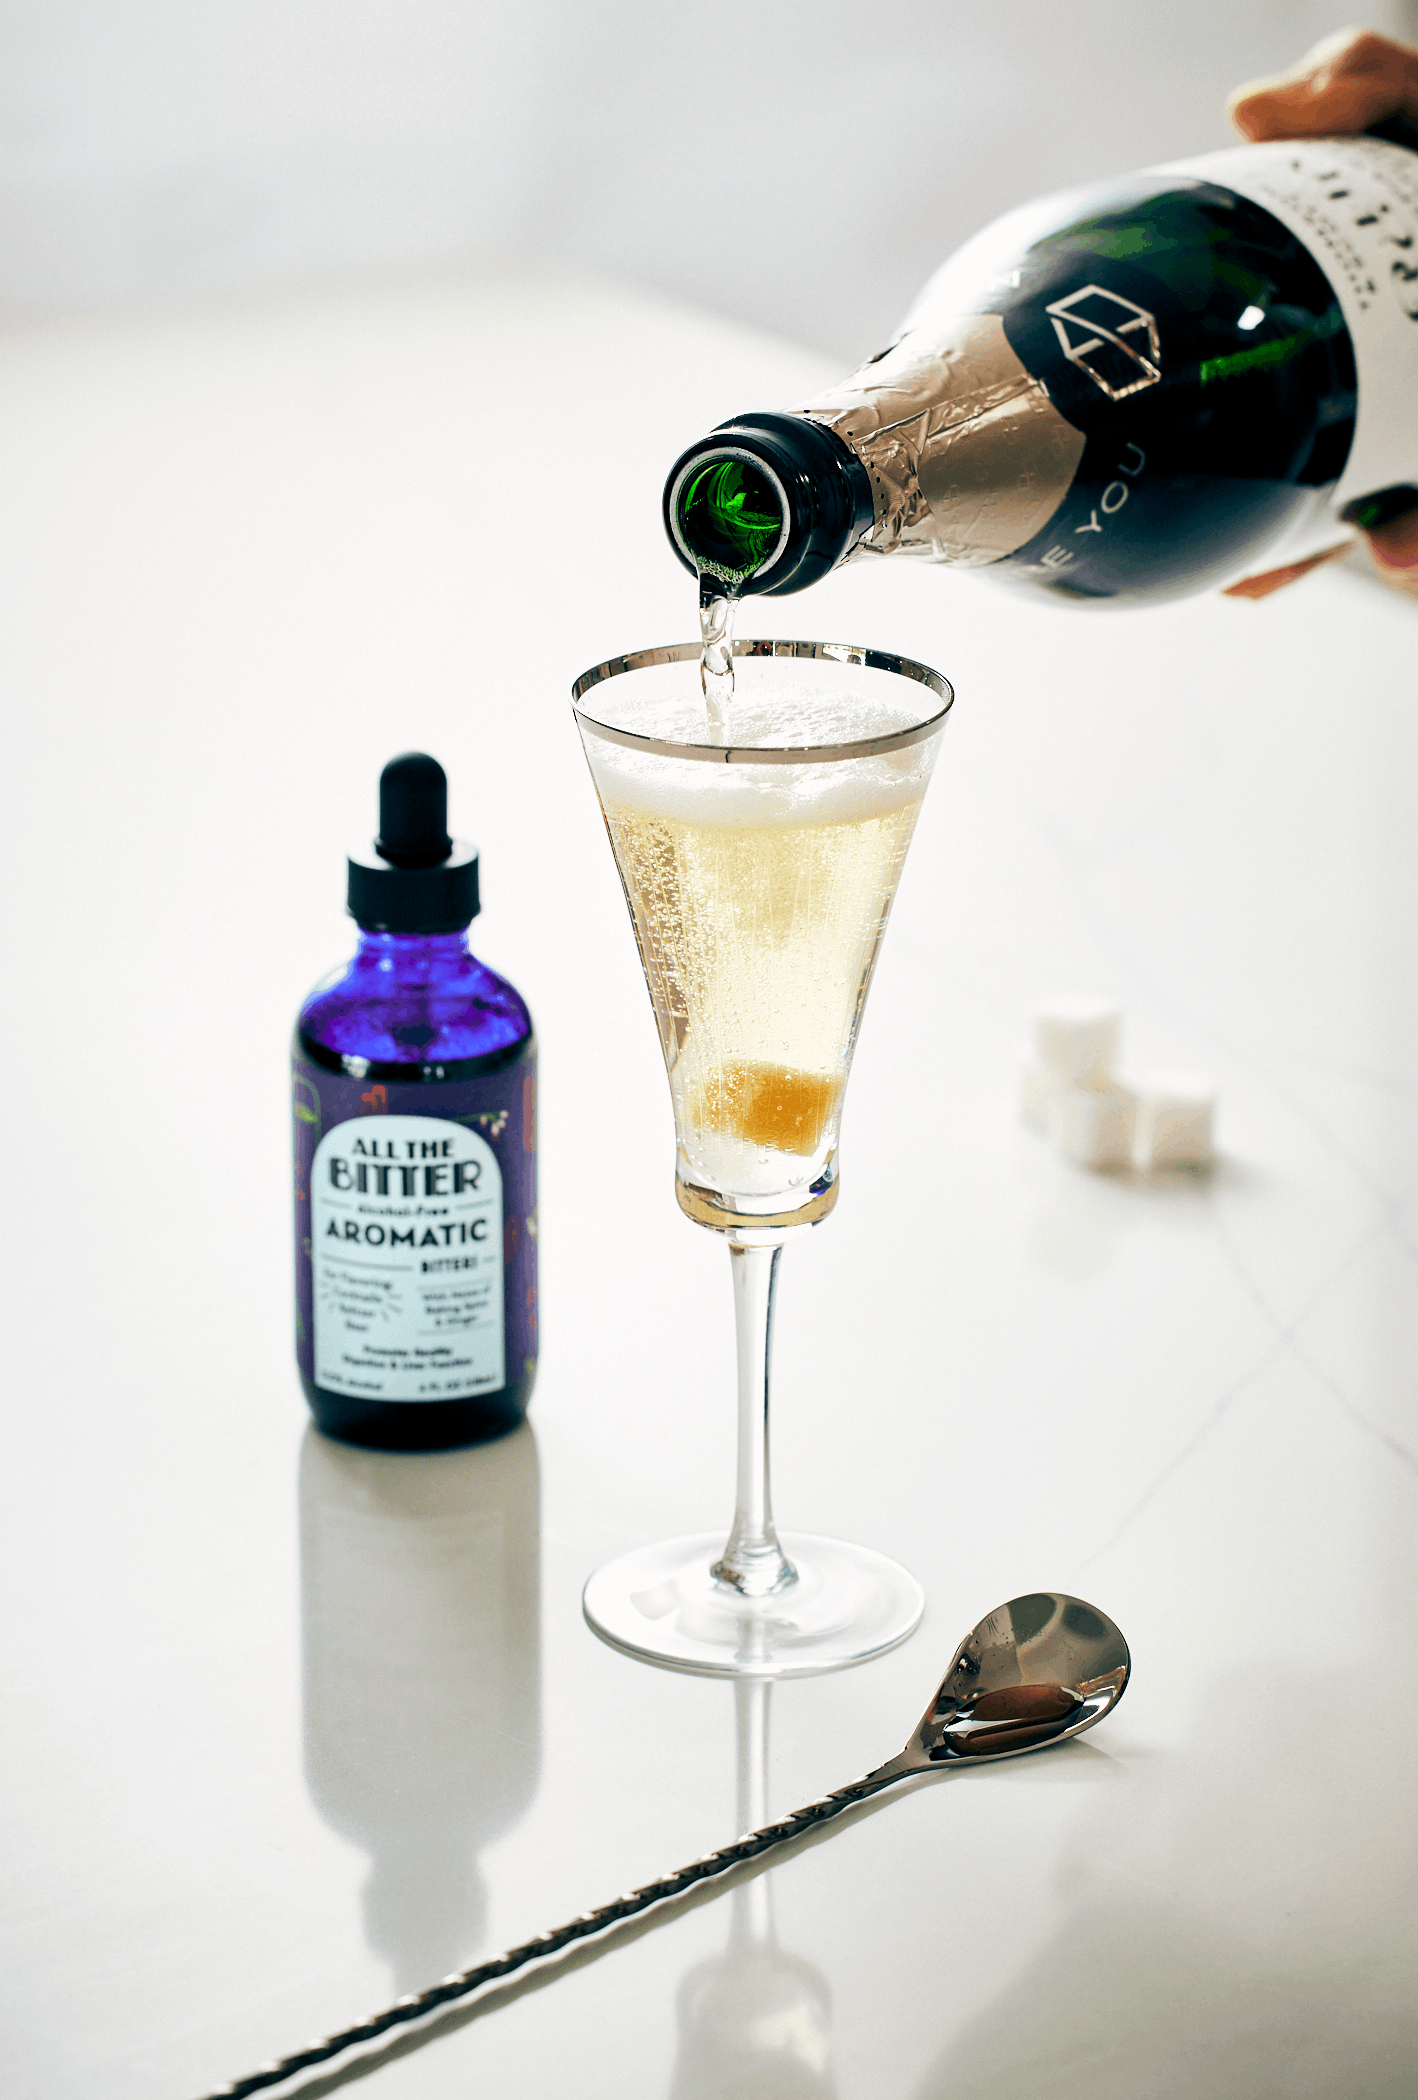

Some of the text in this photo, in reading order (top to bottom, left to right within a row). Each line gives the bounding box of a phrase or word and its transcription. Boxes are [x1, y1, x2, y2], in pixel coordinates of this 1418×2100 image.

[1074, 441, 1146, 534] YOU
[352, 1138, 453, 1159] ALL THE
[329, 1156, 482, 1197] BITTER
[326, 1216, 488, 1248] AROMATIC
